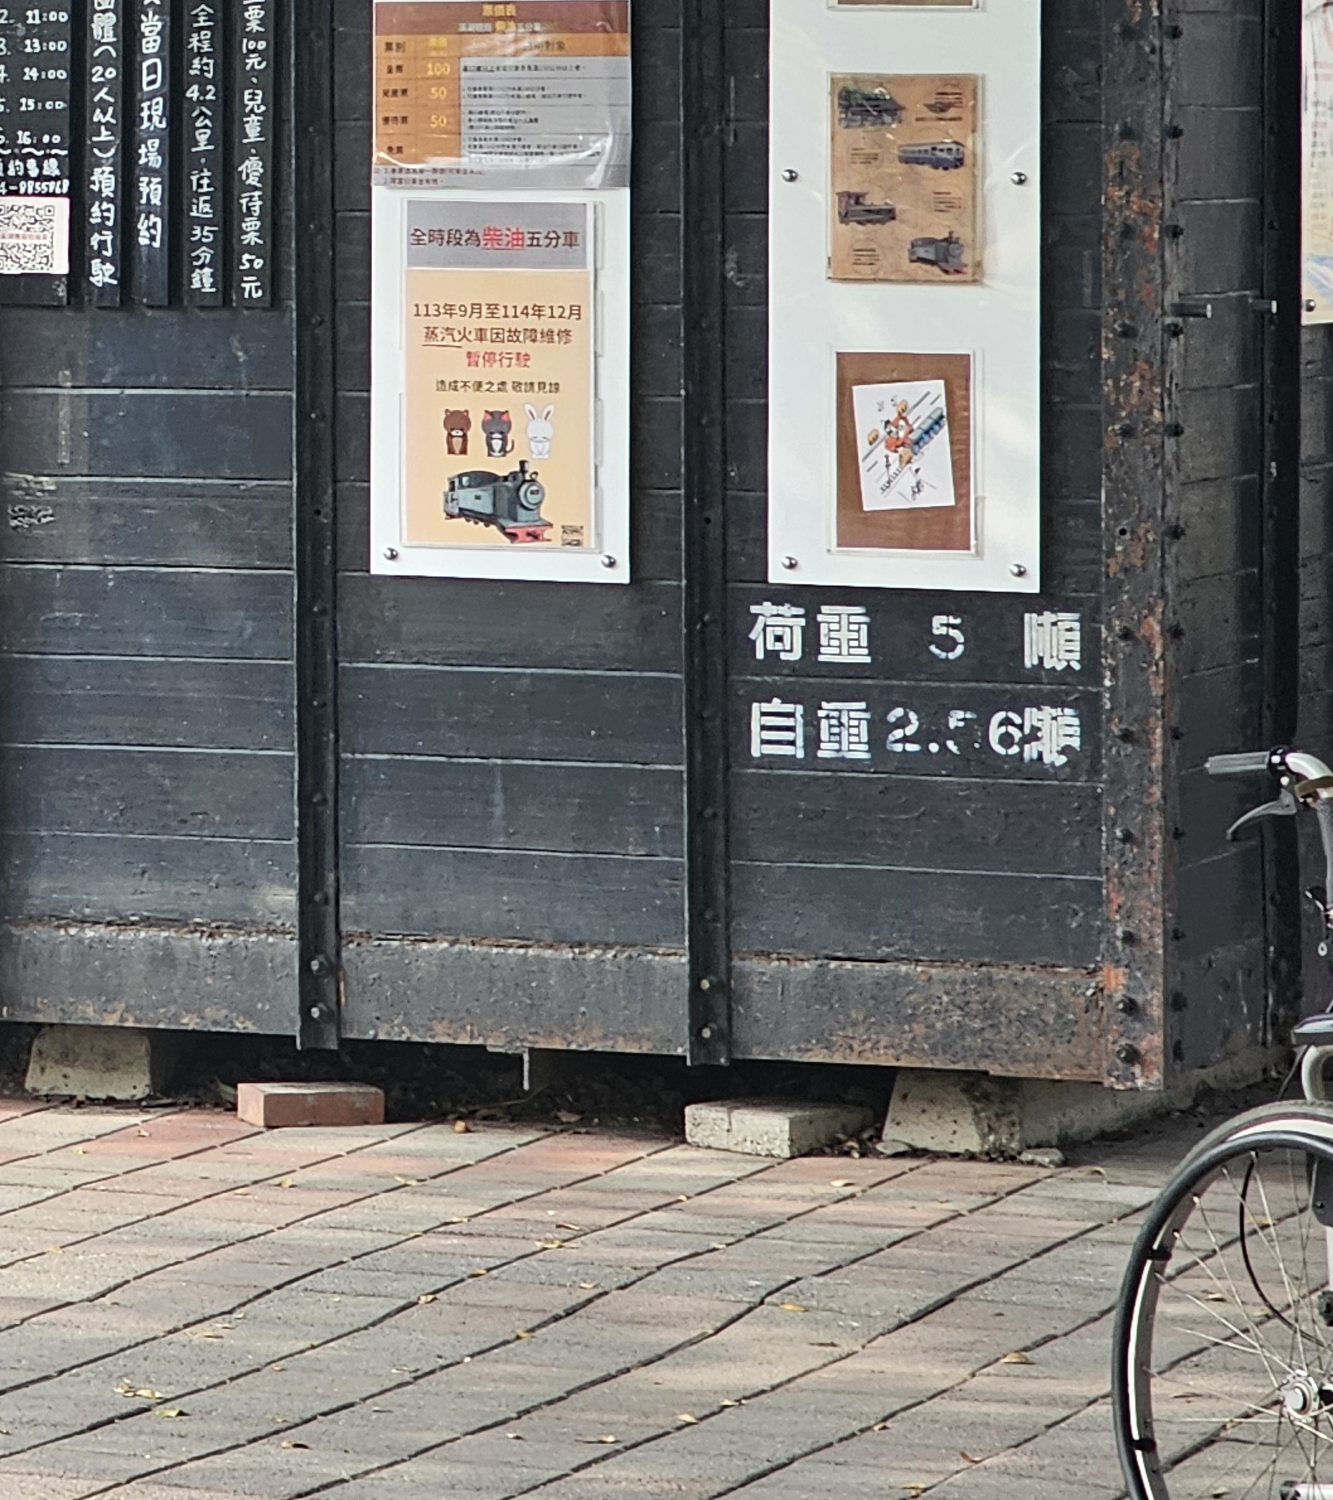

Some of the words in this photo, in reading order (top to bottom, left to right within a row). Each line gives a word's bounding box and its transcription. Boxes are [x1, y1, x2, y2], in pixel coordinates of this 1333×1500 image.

[25, 9, 68, 24] 11:00
[24, 38, 67, 53] 13:00
[23, 67, 67, 81] 14:00
[426, 63, 451, 76] 100
[430, 86, 448, 99] 50
[19, 97, 65, 111] 15:00
[430, 115, 448, 128] 50
[16, 130, 61, 145] 16:00
[410, 226, 580, 250] 全時段為柴油五分車
[413, 302, 582, 321] 113年9月至114年12月
[423, 325, 573, 345] 蒸汽火車因故障維修
[466, 351, 532, 369] 暫停行駛
[435, 379, 507, 393] 造成不便之處
[748, 601, 872, 663] 荷重
[929, 614, 965, 660] 5
[750, 698, 872, 760] 自重
